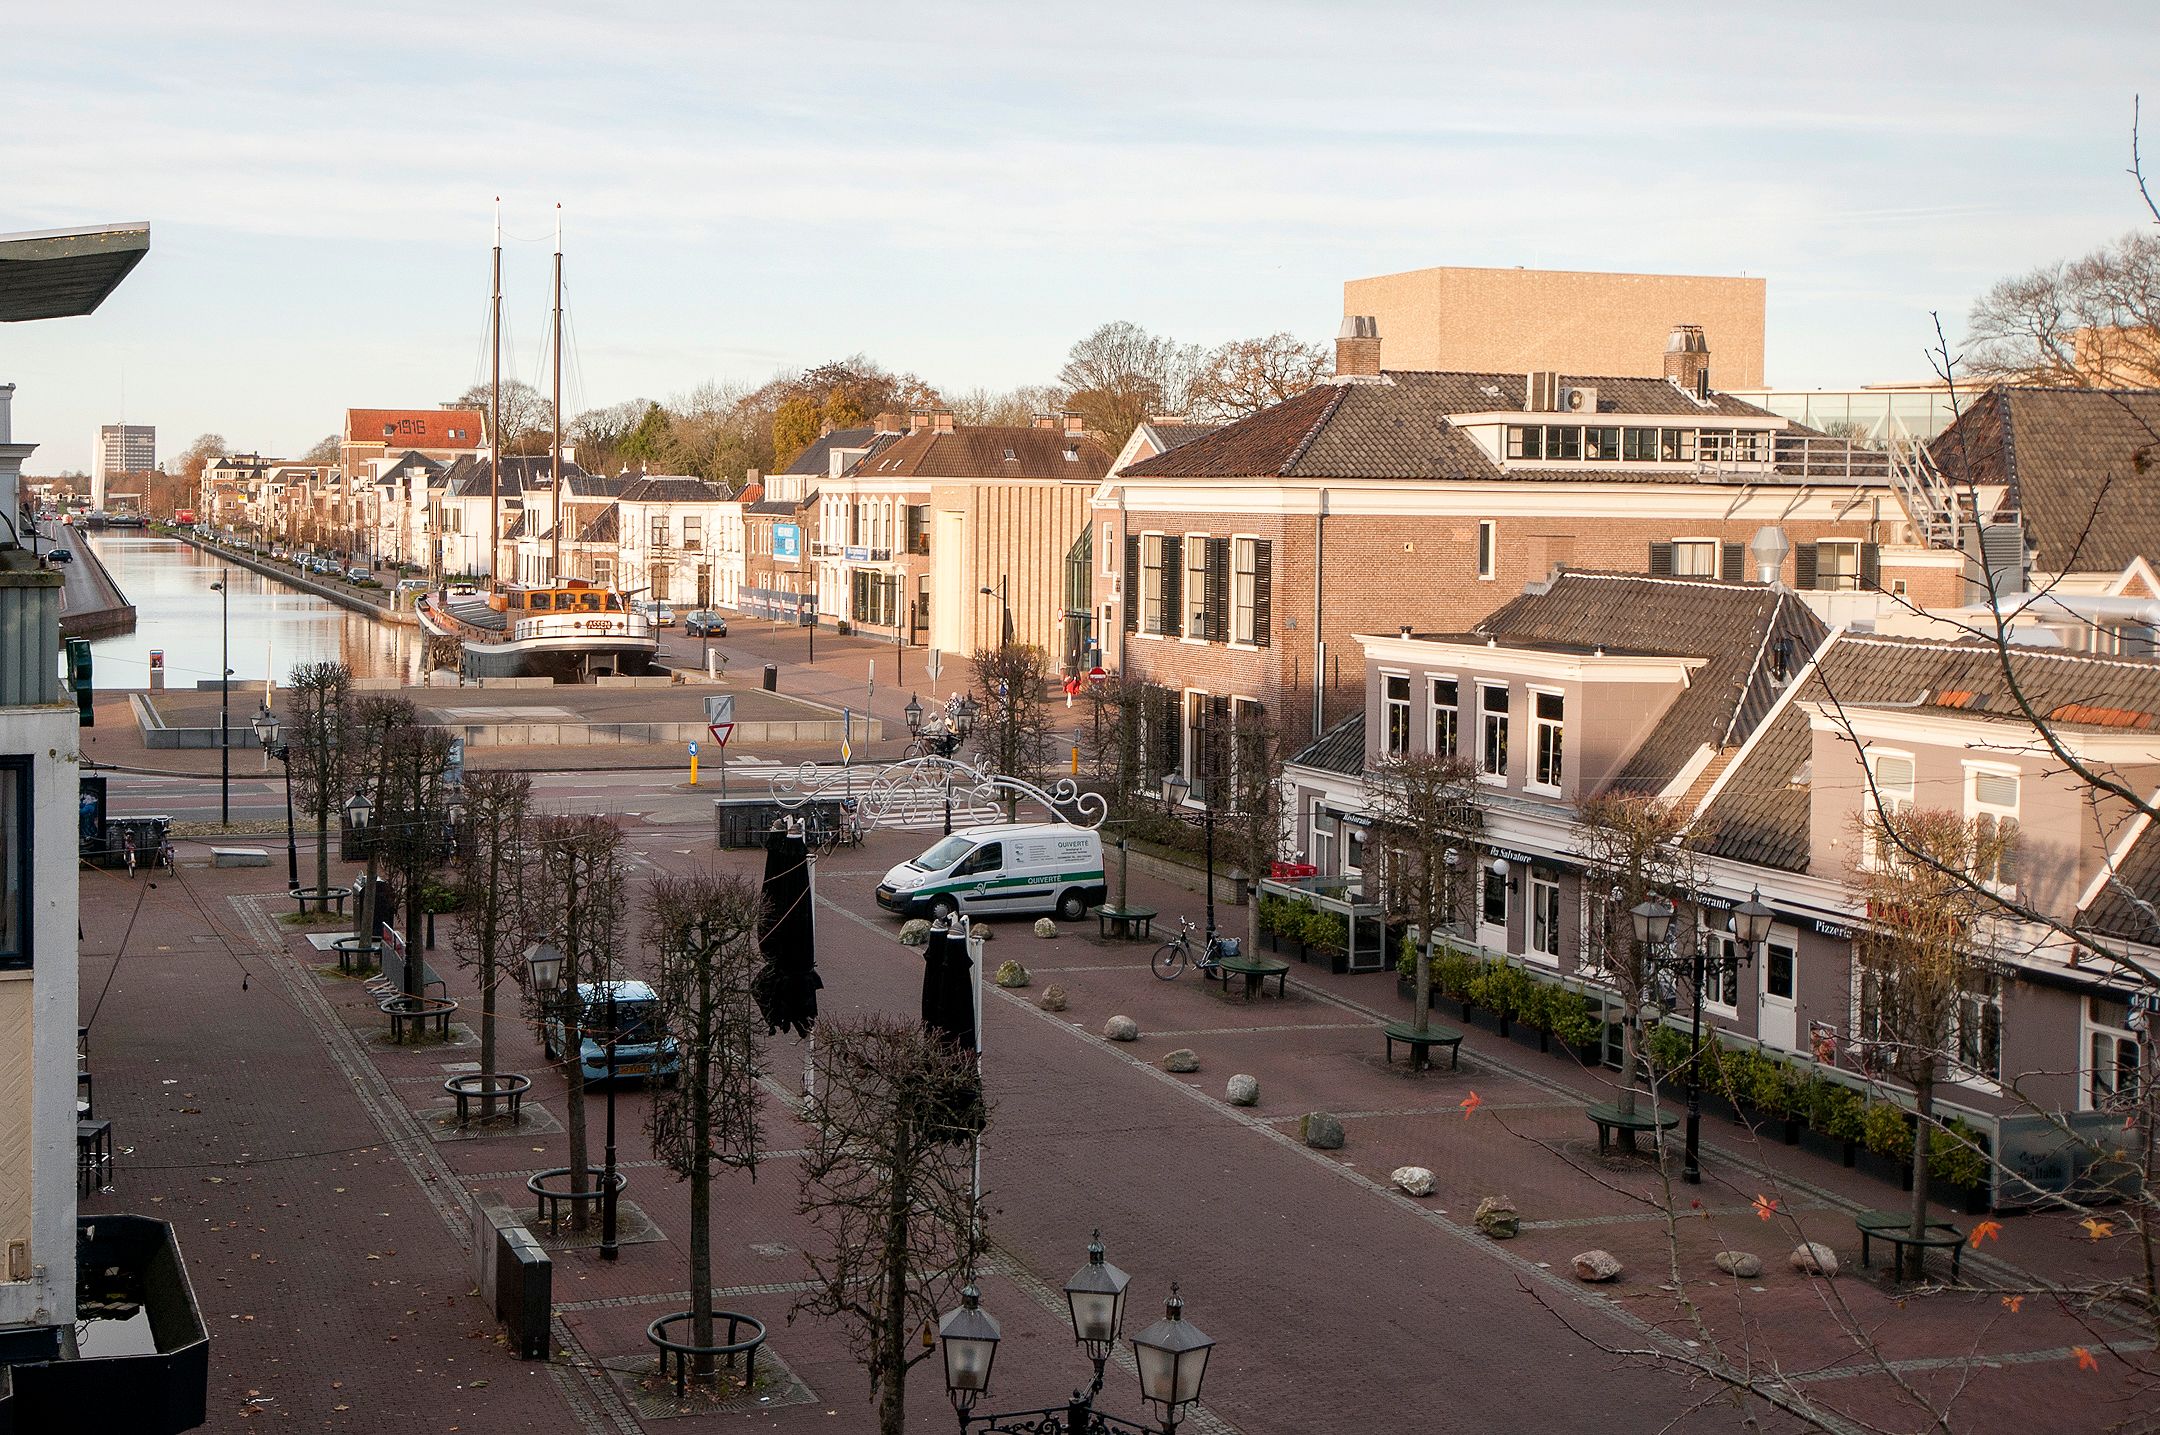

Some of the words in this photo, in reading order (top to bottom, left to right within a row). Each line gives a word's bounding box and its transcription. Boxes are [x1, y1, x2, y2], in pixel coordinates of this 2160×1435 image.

[588, 621, 611, 629] ASSEN
[1057, 840, 1089, 848] QUIVERTÉ
[1499, 848, 1532, 864] Salvatore
[1028, 875, 1062, 884] QUIVERTÉ
[1815, 920, 1853, 939] Pizzeria
